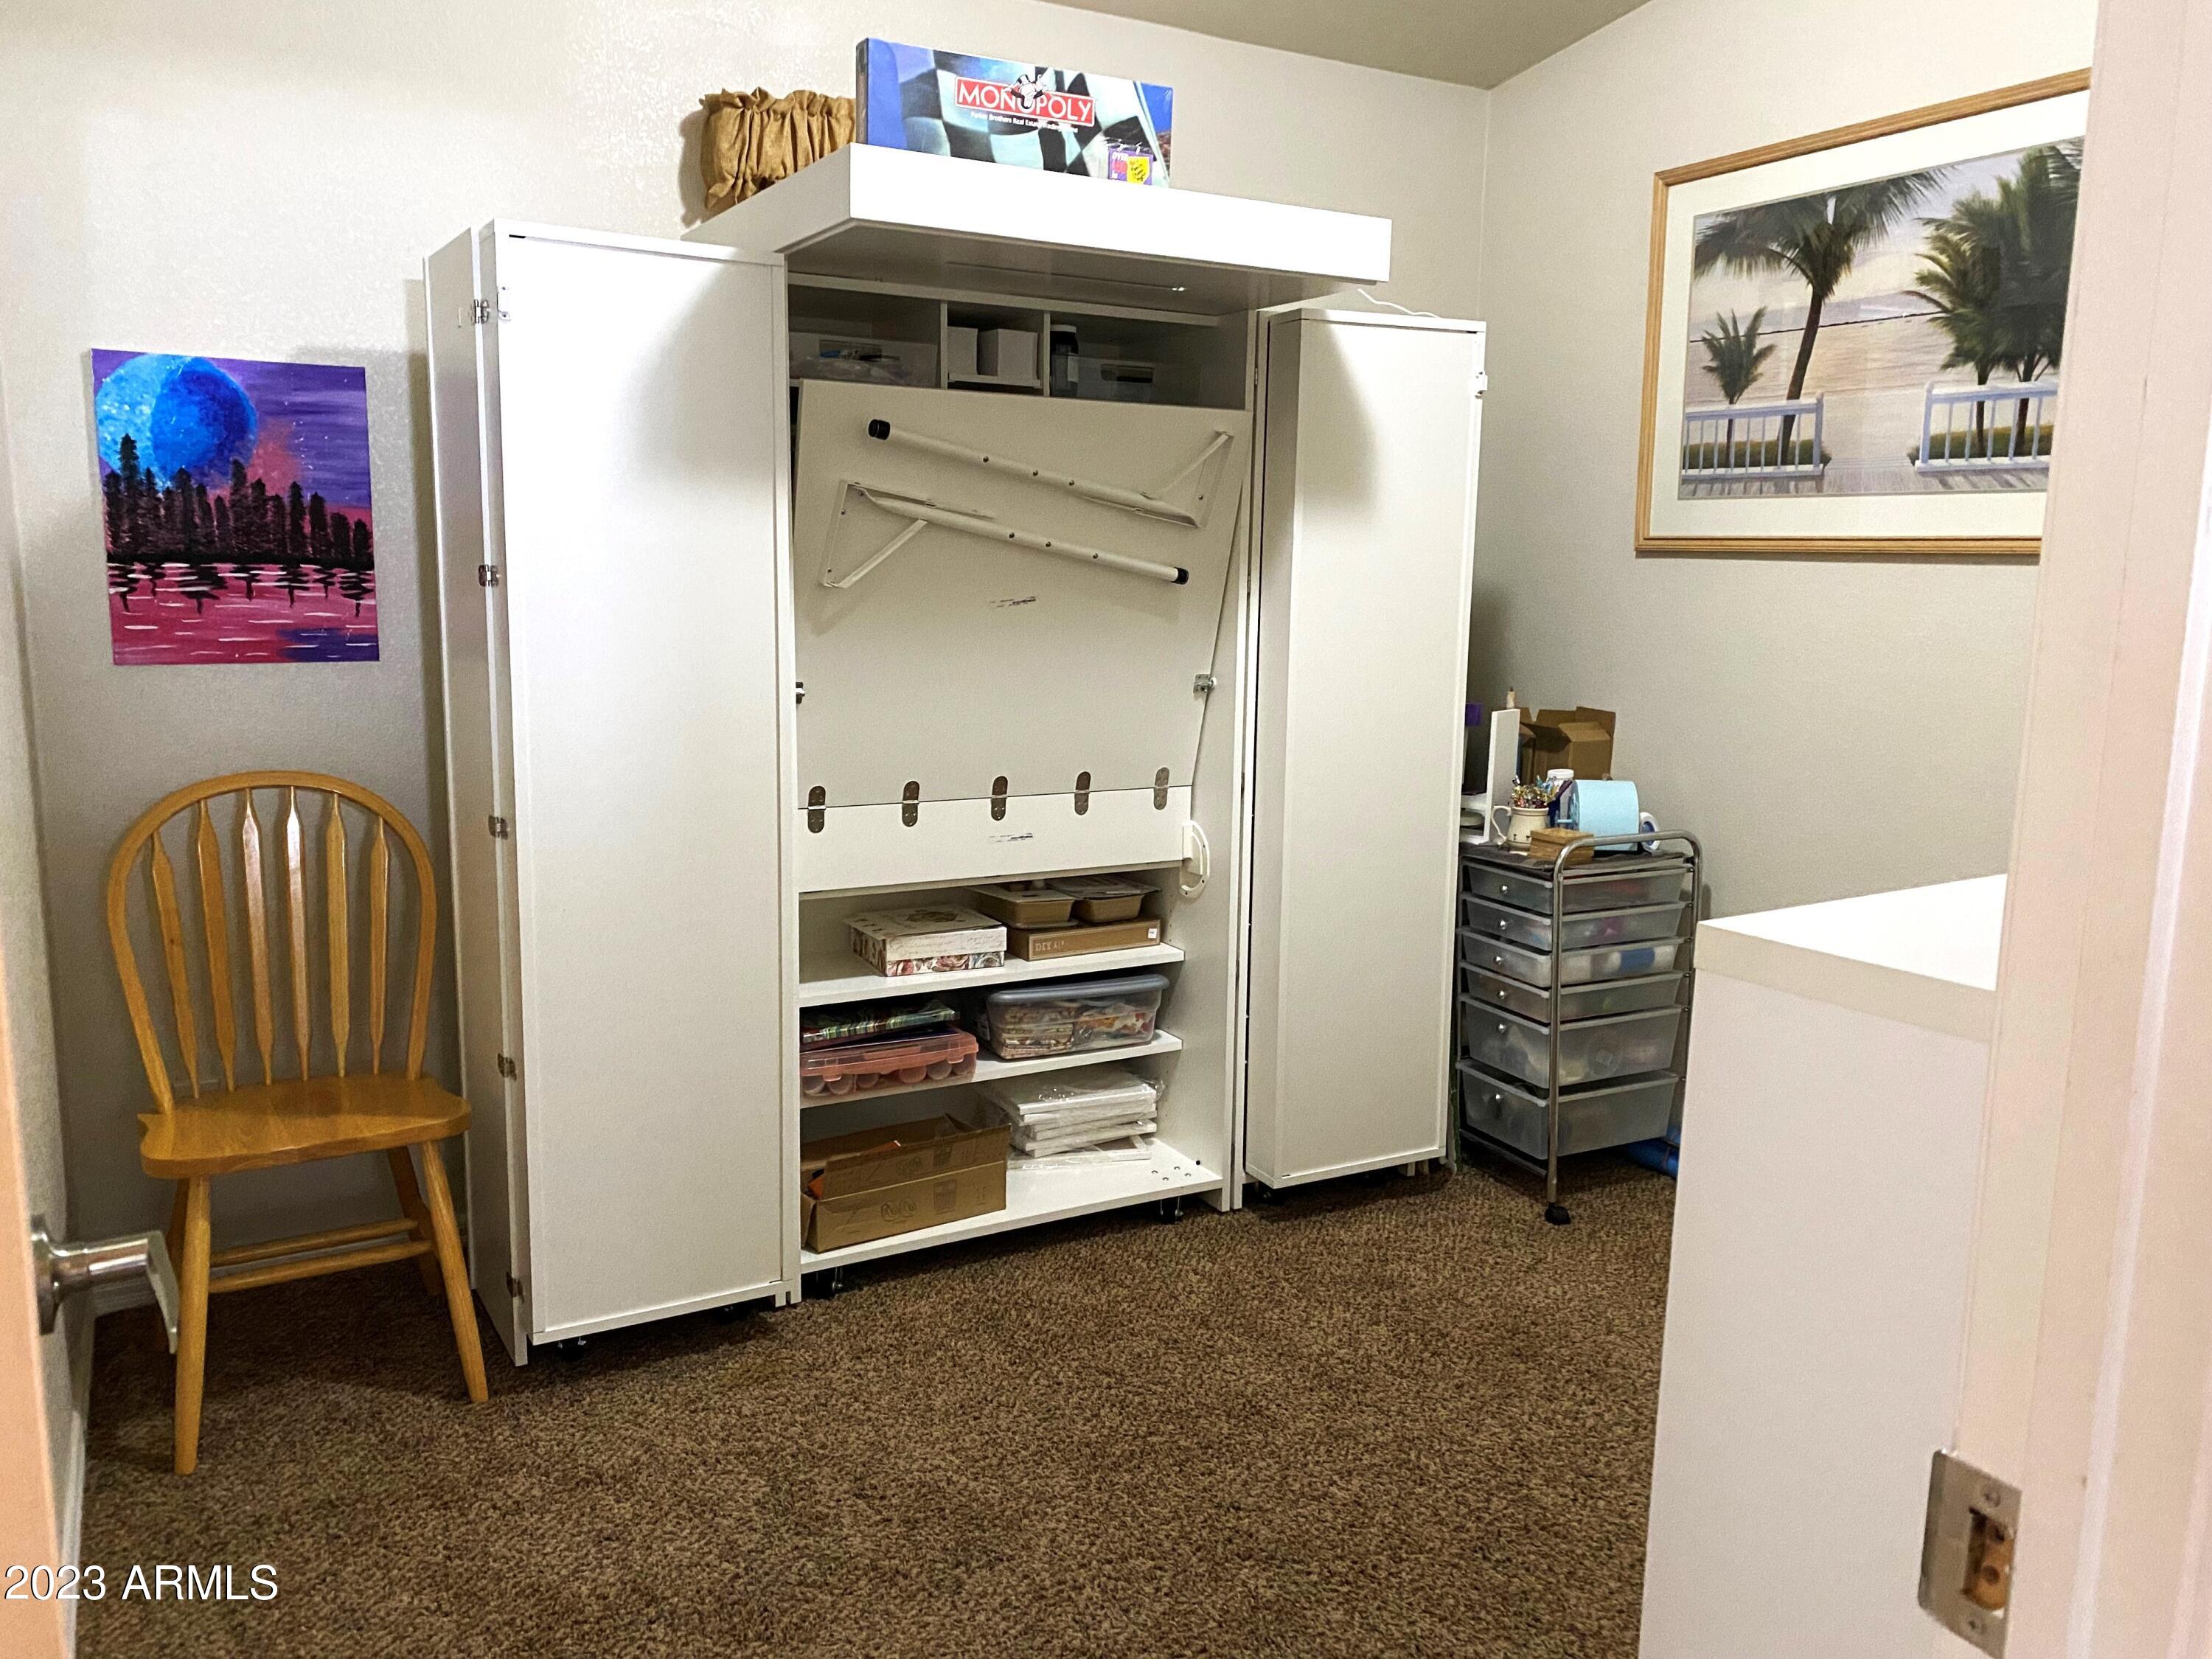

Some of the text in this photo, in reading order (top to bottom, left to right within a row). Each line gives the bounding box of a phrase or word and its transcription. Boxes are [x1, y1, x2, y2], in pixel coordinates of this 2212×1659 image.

[959, 83, 1092, 122] MONOPOLY
[989, 114, 1012, 124] Brothers
[1012, 117, 1025, 125] Real
[1035, 942, 1051, 951] DIY
